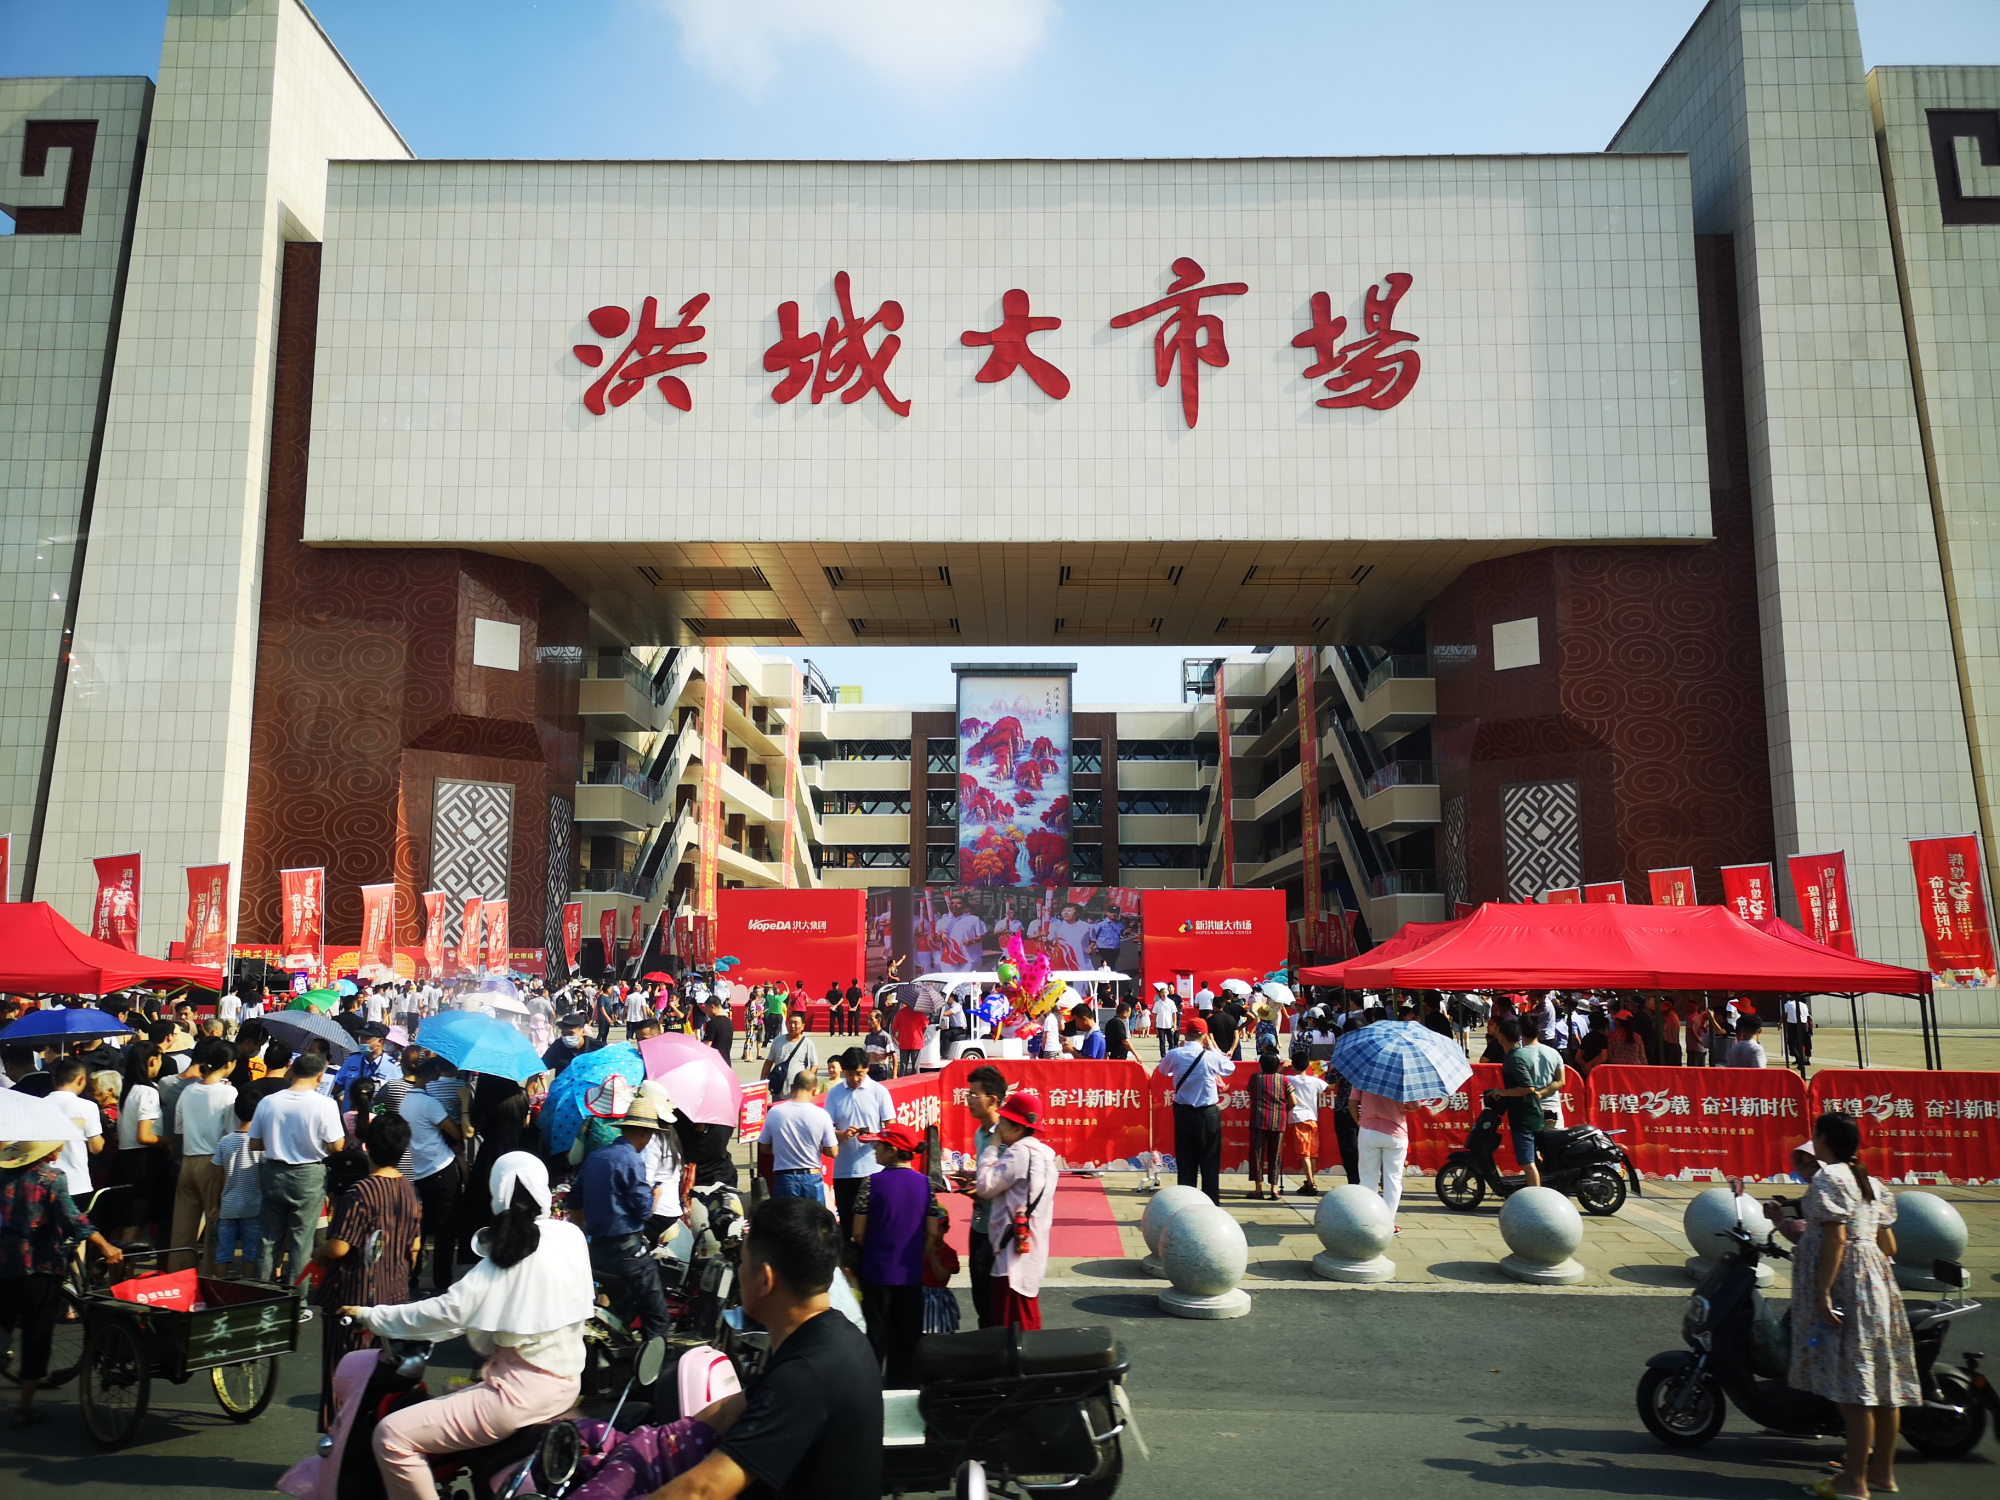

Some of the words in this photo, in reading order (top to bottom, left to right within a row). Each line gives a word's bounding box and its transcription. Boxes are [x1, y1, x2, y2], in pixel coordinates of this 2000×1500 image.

[1195, 920, 1252, 930] 新洪城大市场
[1048, 1087, 1141, 1110] 奋斗新时代
[1599, 1088, 1690, 1118] 辉煌25载
[1701, 1095, 1799, 1118] 奋斗新时代
[1823, 1091, 1915, 1122] 辉煌25载
